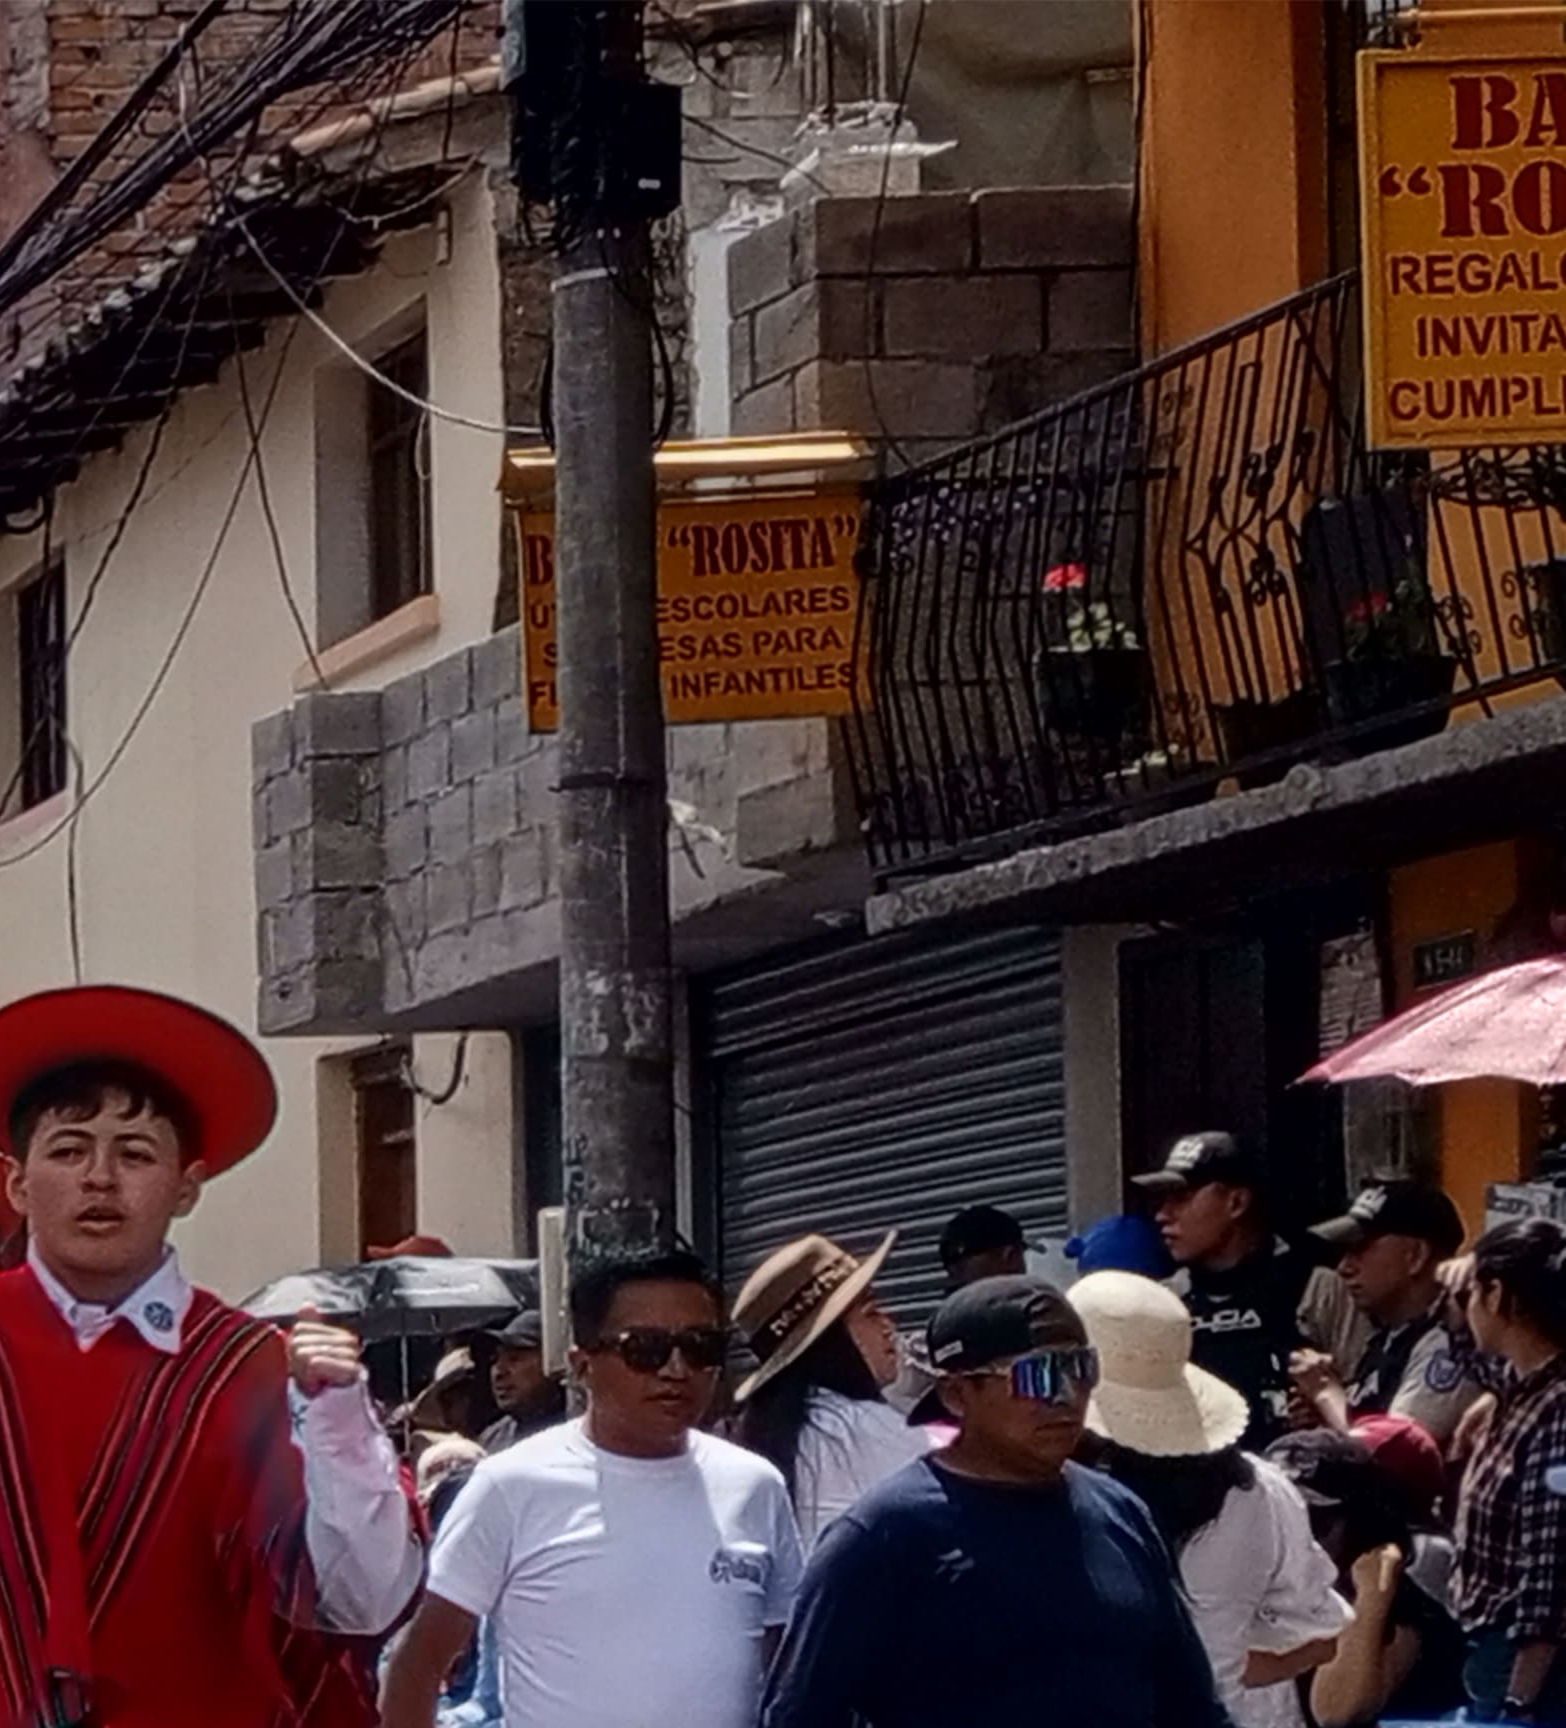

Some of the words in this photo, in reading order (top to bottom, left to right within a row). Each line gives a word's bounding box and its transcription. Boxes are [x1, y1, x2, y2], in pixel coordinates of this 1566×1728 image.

[656, 586, 850, 624] ESCOLARES
[753, 624, 844, 657] PARA
[671, 662, 859, 700] INFANTILES
